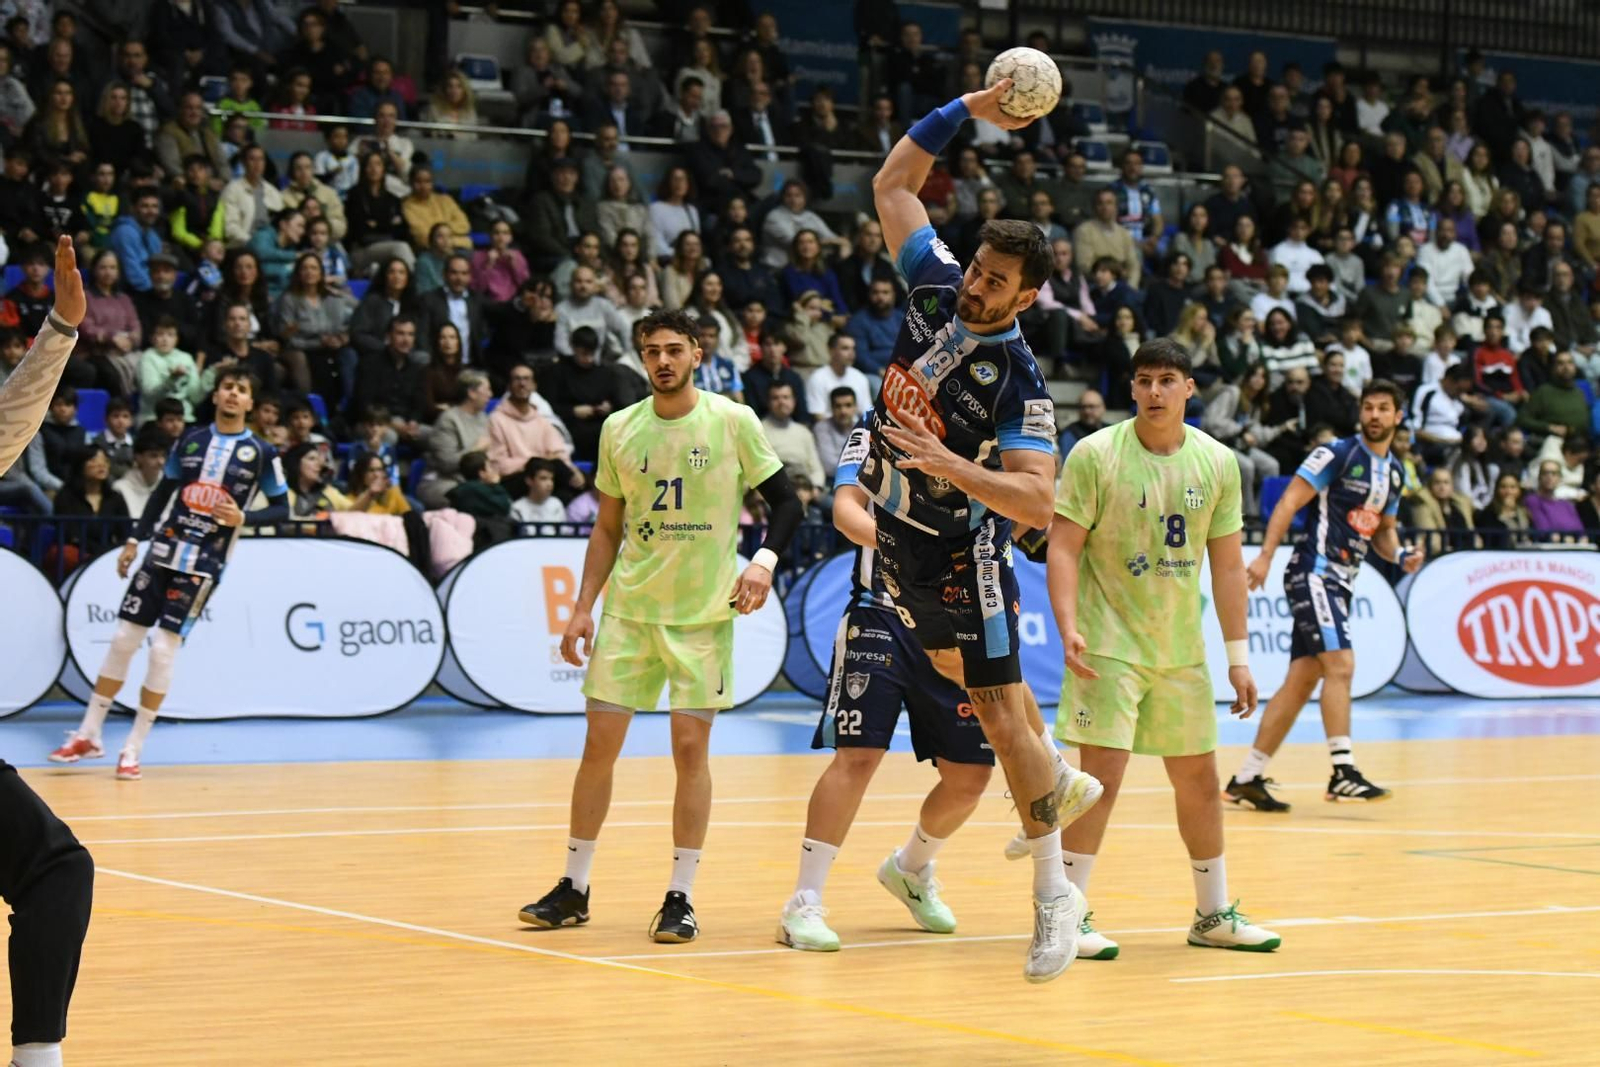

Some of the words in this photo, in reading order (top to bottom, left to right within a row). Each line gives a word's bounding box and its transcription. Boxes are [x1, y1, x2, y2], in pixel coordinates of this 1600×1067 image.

[652, 477, 683, 511] 21
[659, 521, 712, 531] Assistència
[340, 620, 436, 657] gaona
[837, 709, 862, 735] 22
